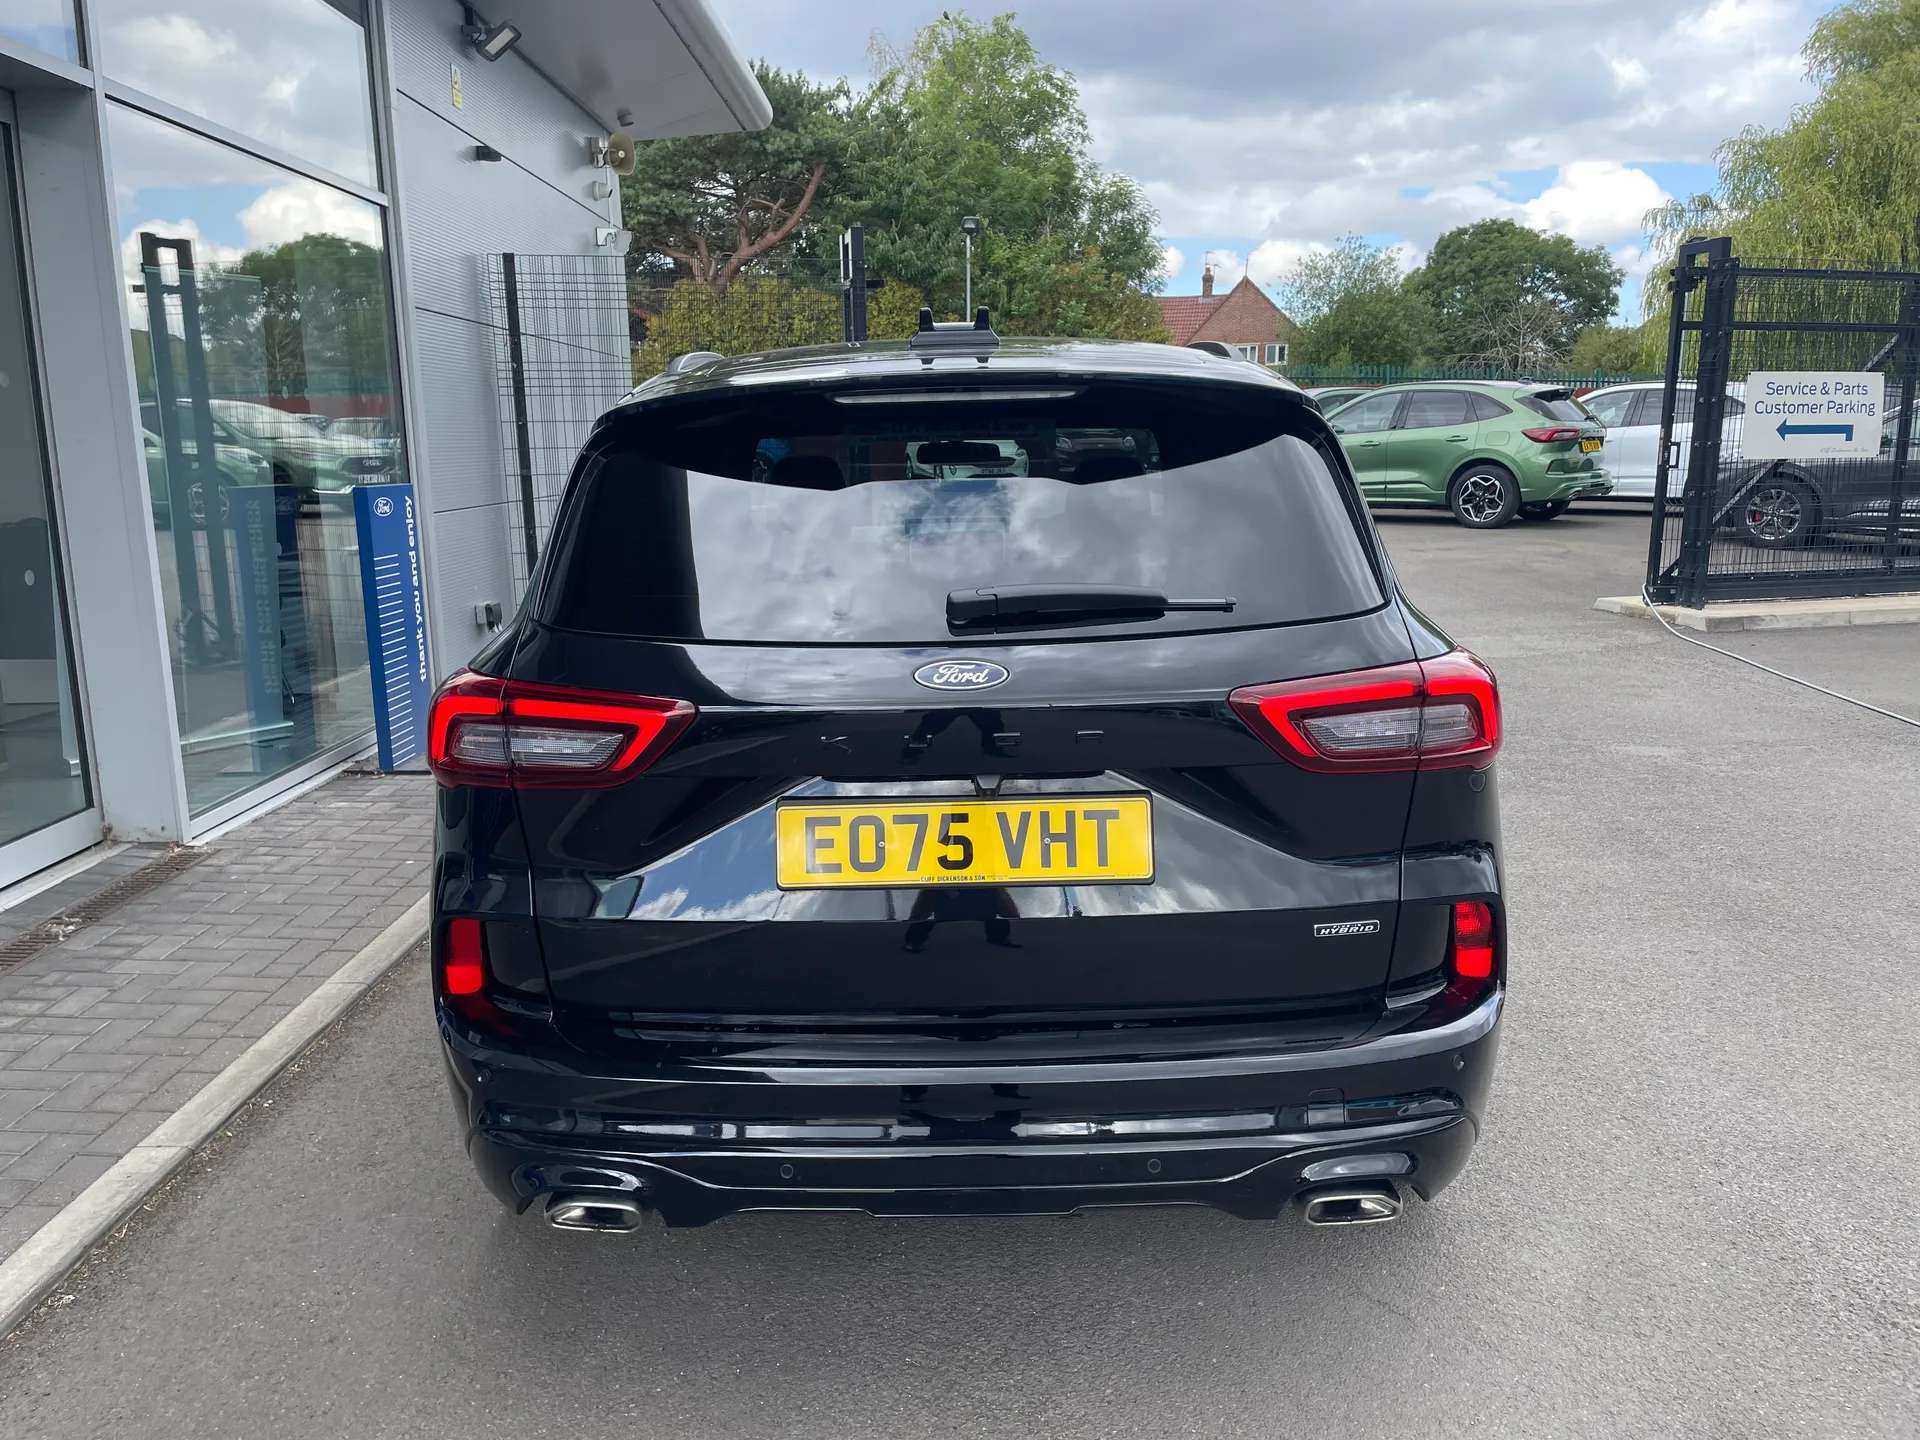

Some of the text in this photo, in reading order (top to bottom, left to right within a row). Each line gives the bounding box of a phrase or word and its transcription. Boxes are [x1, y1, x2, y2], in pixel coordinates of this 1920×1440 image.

[1766, 382, 1868, 395] Service & Parts
[1754, 401, 1876, 416] Customer Parking
[404, 495, 427, 682] thank you and enjoy
[933, 664, 990, 684] Ford
[805, 809, 1120, 875] EO75 VHT
[1320, 924, 1374, 935] HYBRID
